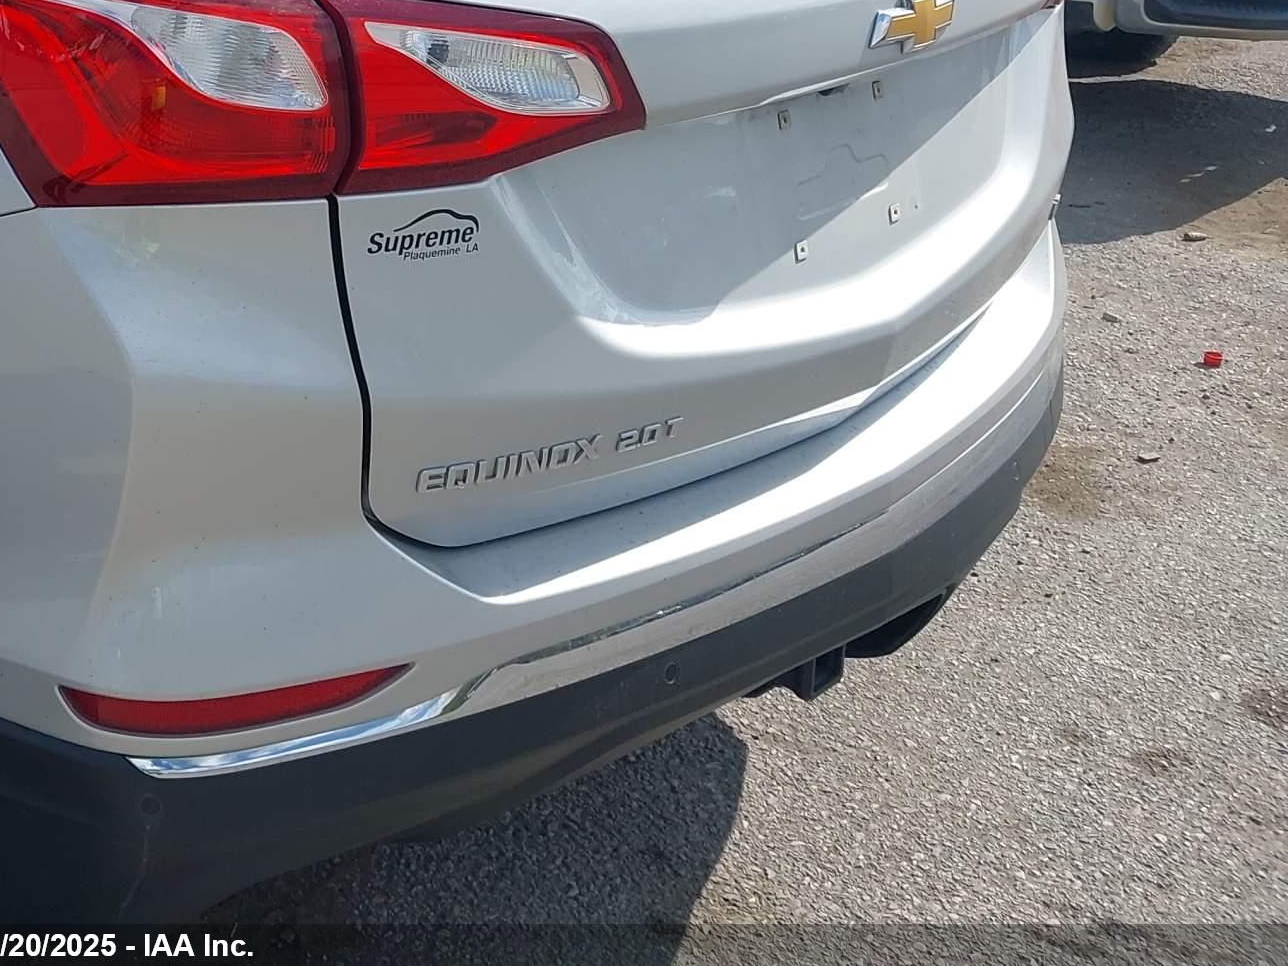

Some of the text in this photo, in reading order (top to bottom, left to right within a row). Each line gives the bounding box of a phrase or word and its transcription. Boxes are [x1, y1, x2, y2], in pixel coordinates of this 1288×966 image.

[367, 226, 475, 255] Supreme
[466, 242, 479, 253] LA
[416, 433, 604, 494] EQUINOX
